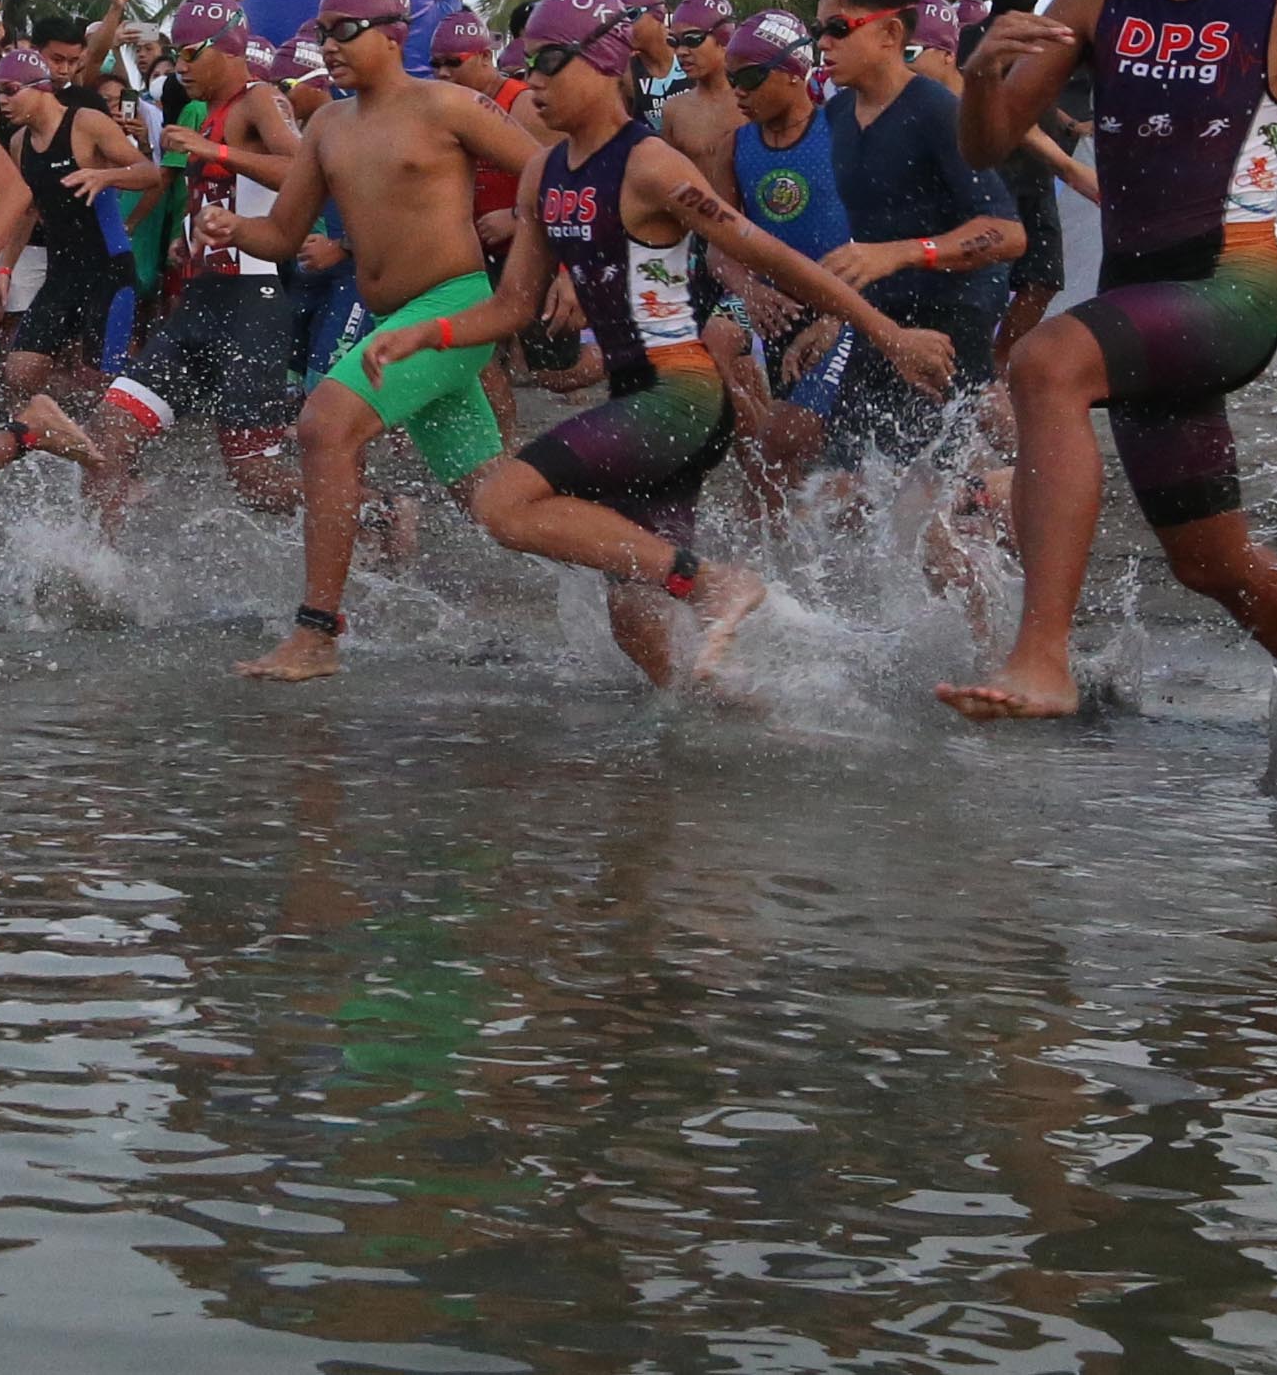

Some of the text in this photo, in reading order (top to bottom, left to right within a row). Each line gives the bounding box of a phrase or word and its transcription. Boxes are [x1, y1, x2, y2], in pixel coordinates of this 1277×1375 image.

[1115, 16, 1230, 63] DPS
[1118, 59, 1218, 84] racing
[543, 186, 597, 224] DPS
[547, 224, 592, 241] racing
